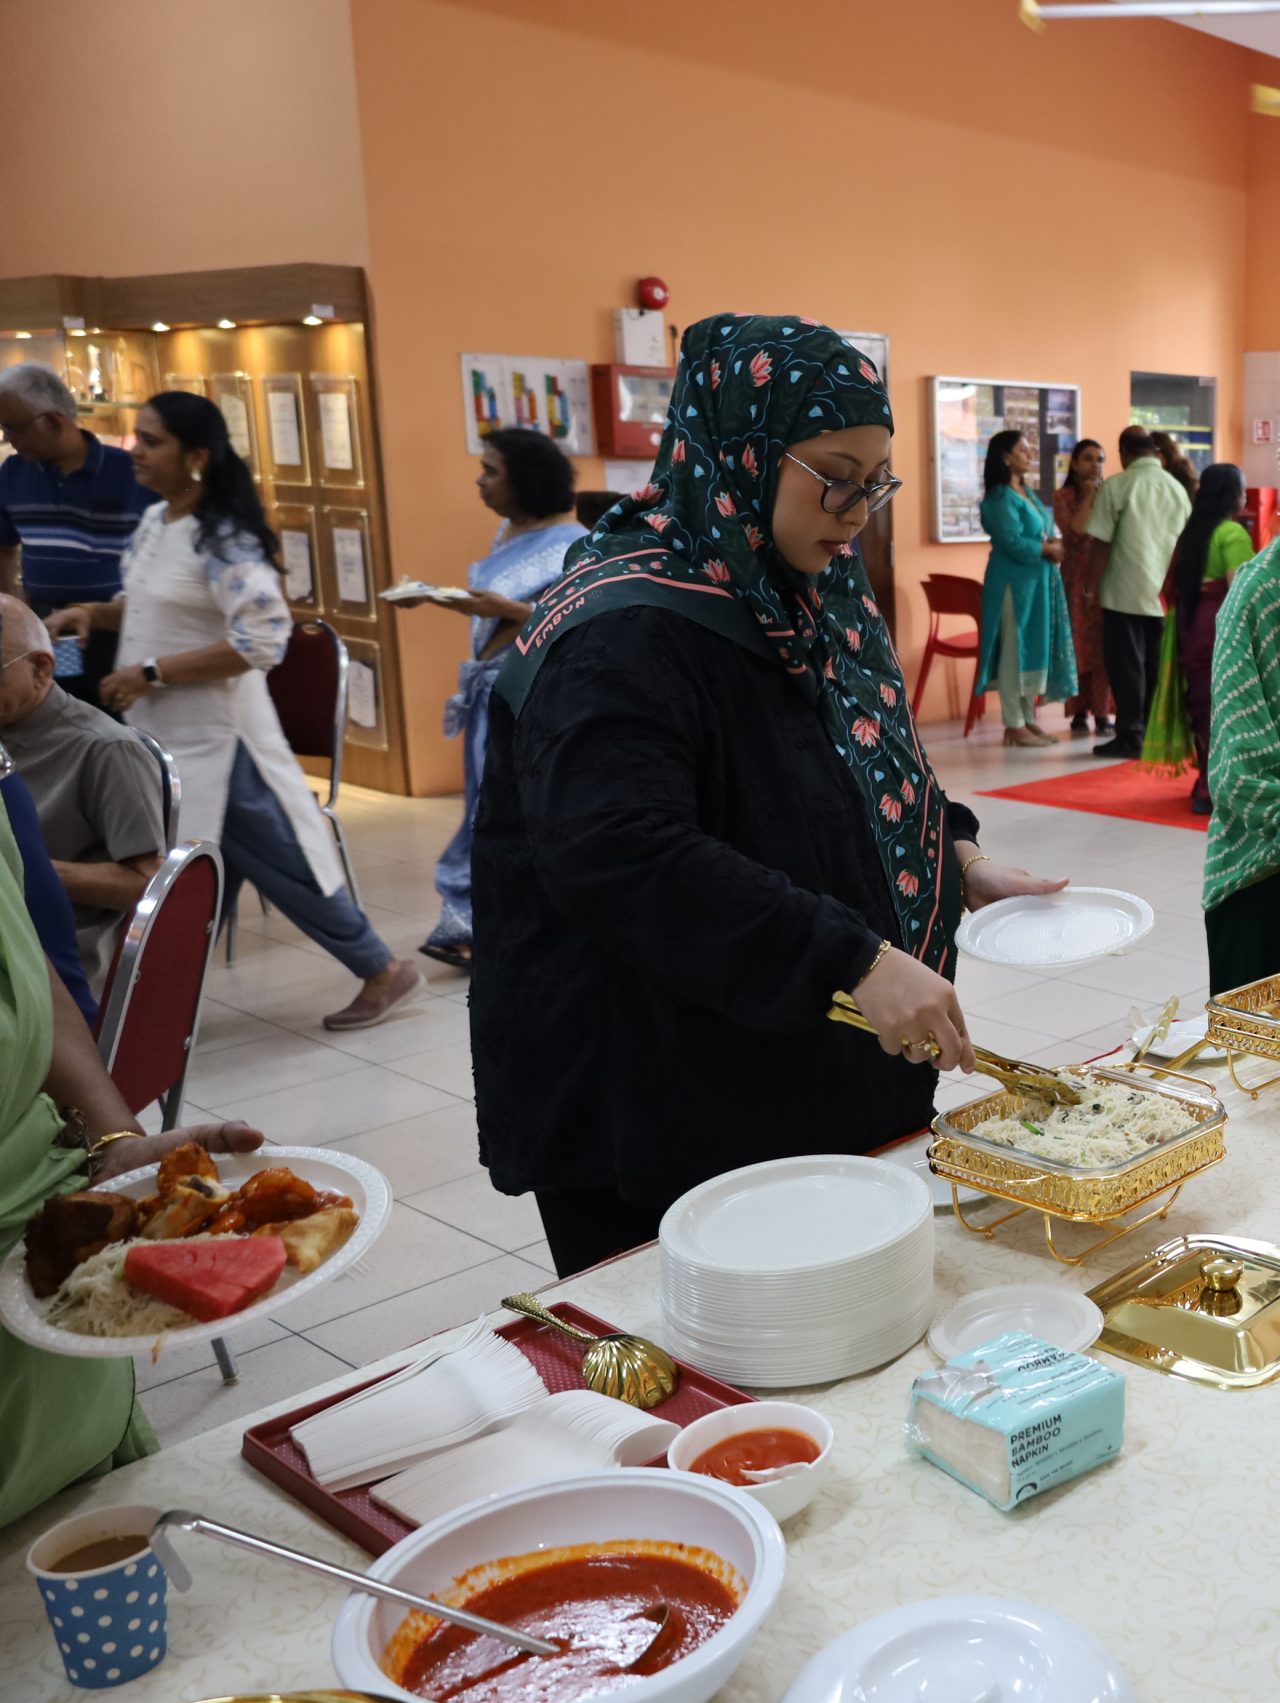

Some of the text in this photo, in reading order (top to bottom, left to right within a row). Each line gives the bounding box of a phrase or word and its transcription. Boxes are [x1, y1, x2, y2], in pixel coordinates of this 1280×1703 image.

[1010, 1413, 1062, 1445] PREMIUM
[1012, 1427, 1061, 1457] BAMBOO
[1012, 1443, 1049, 1469] NAPKIN
